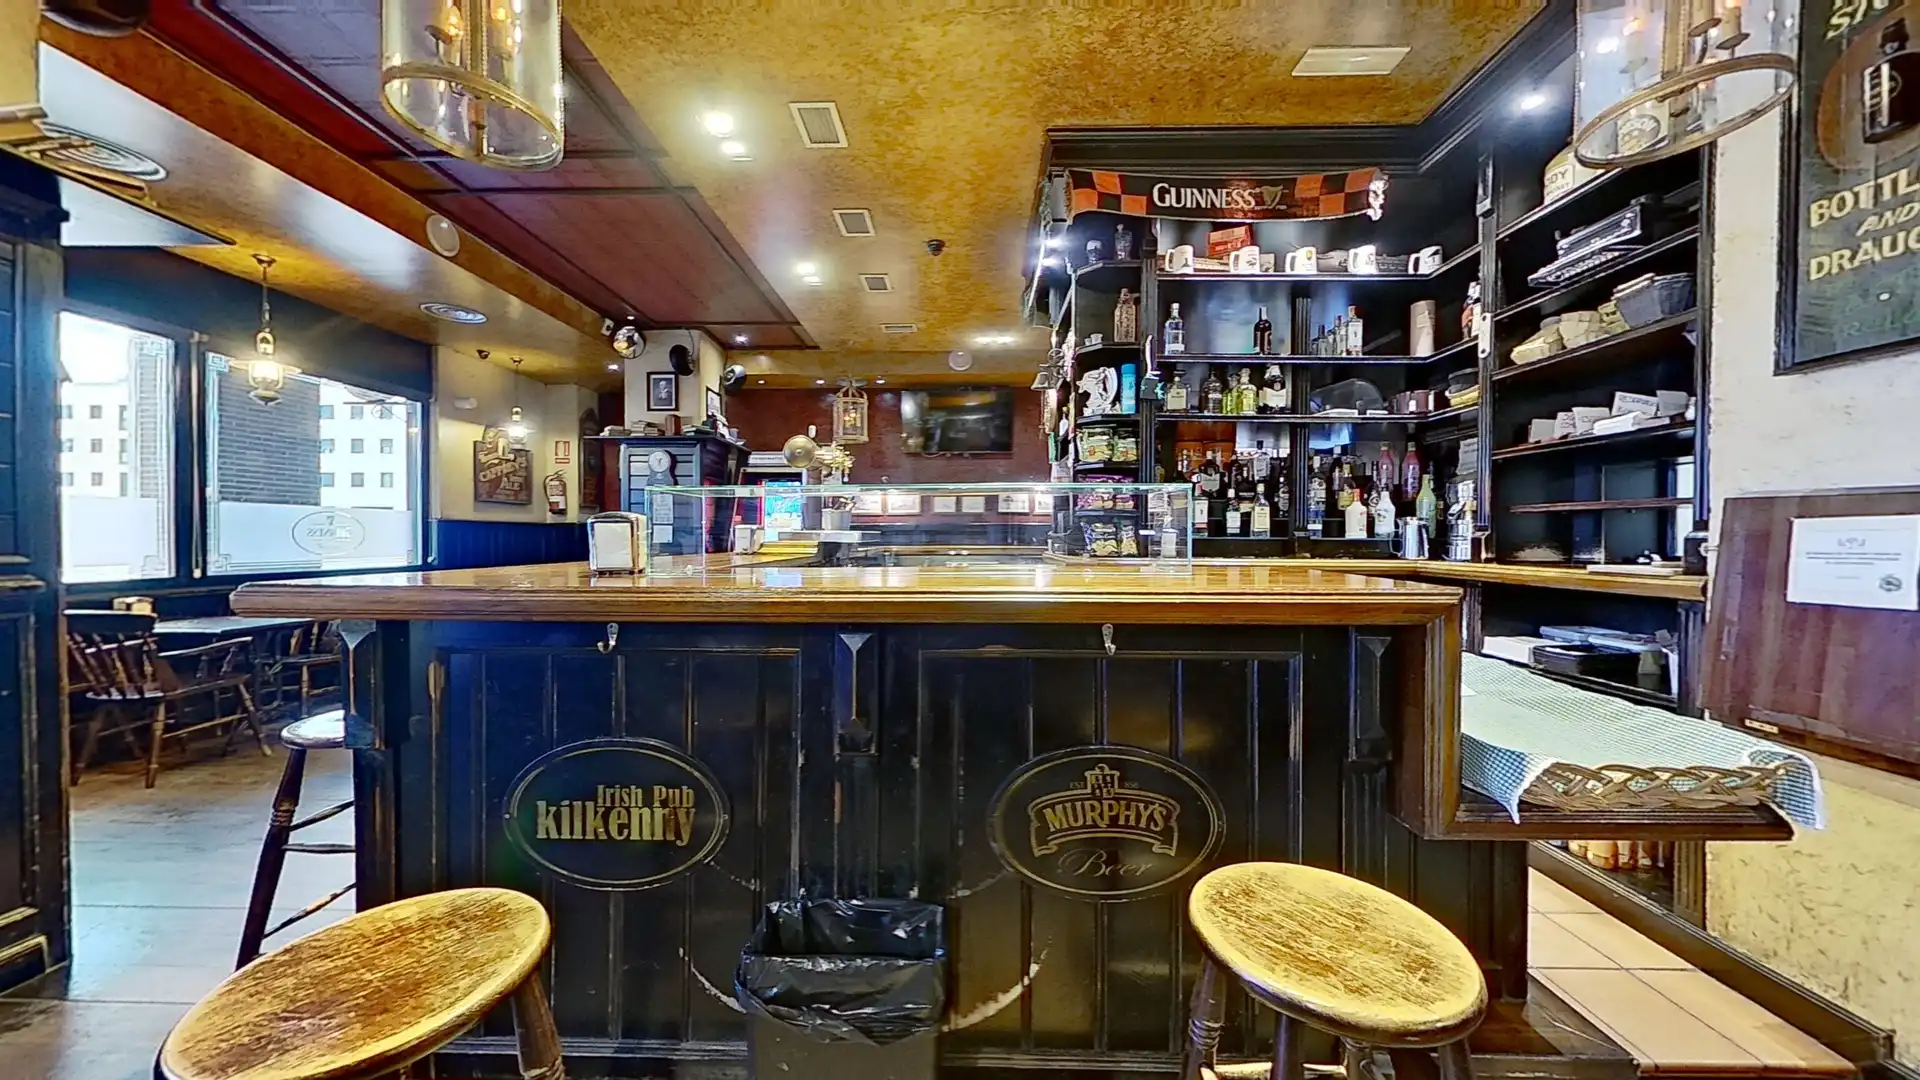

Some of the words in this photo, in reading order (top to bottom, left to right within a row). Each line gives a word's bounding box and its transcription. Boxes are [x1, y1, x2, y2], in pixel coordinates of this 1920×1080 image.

[1152, 182, 1256, 209] GUINNESS
[1855, 201, 1920, 237] AND
[596, 784, 643, 807] Irish
[652, 785, 696, 807] Pub
[536, 800, 696, 847] kilkenny
[1057, 848, 1153, 878] Beer
